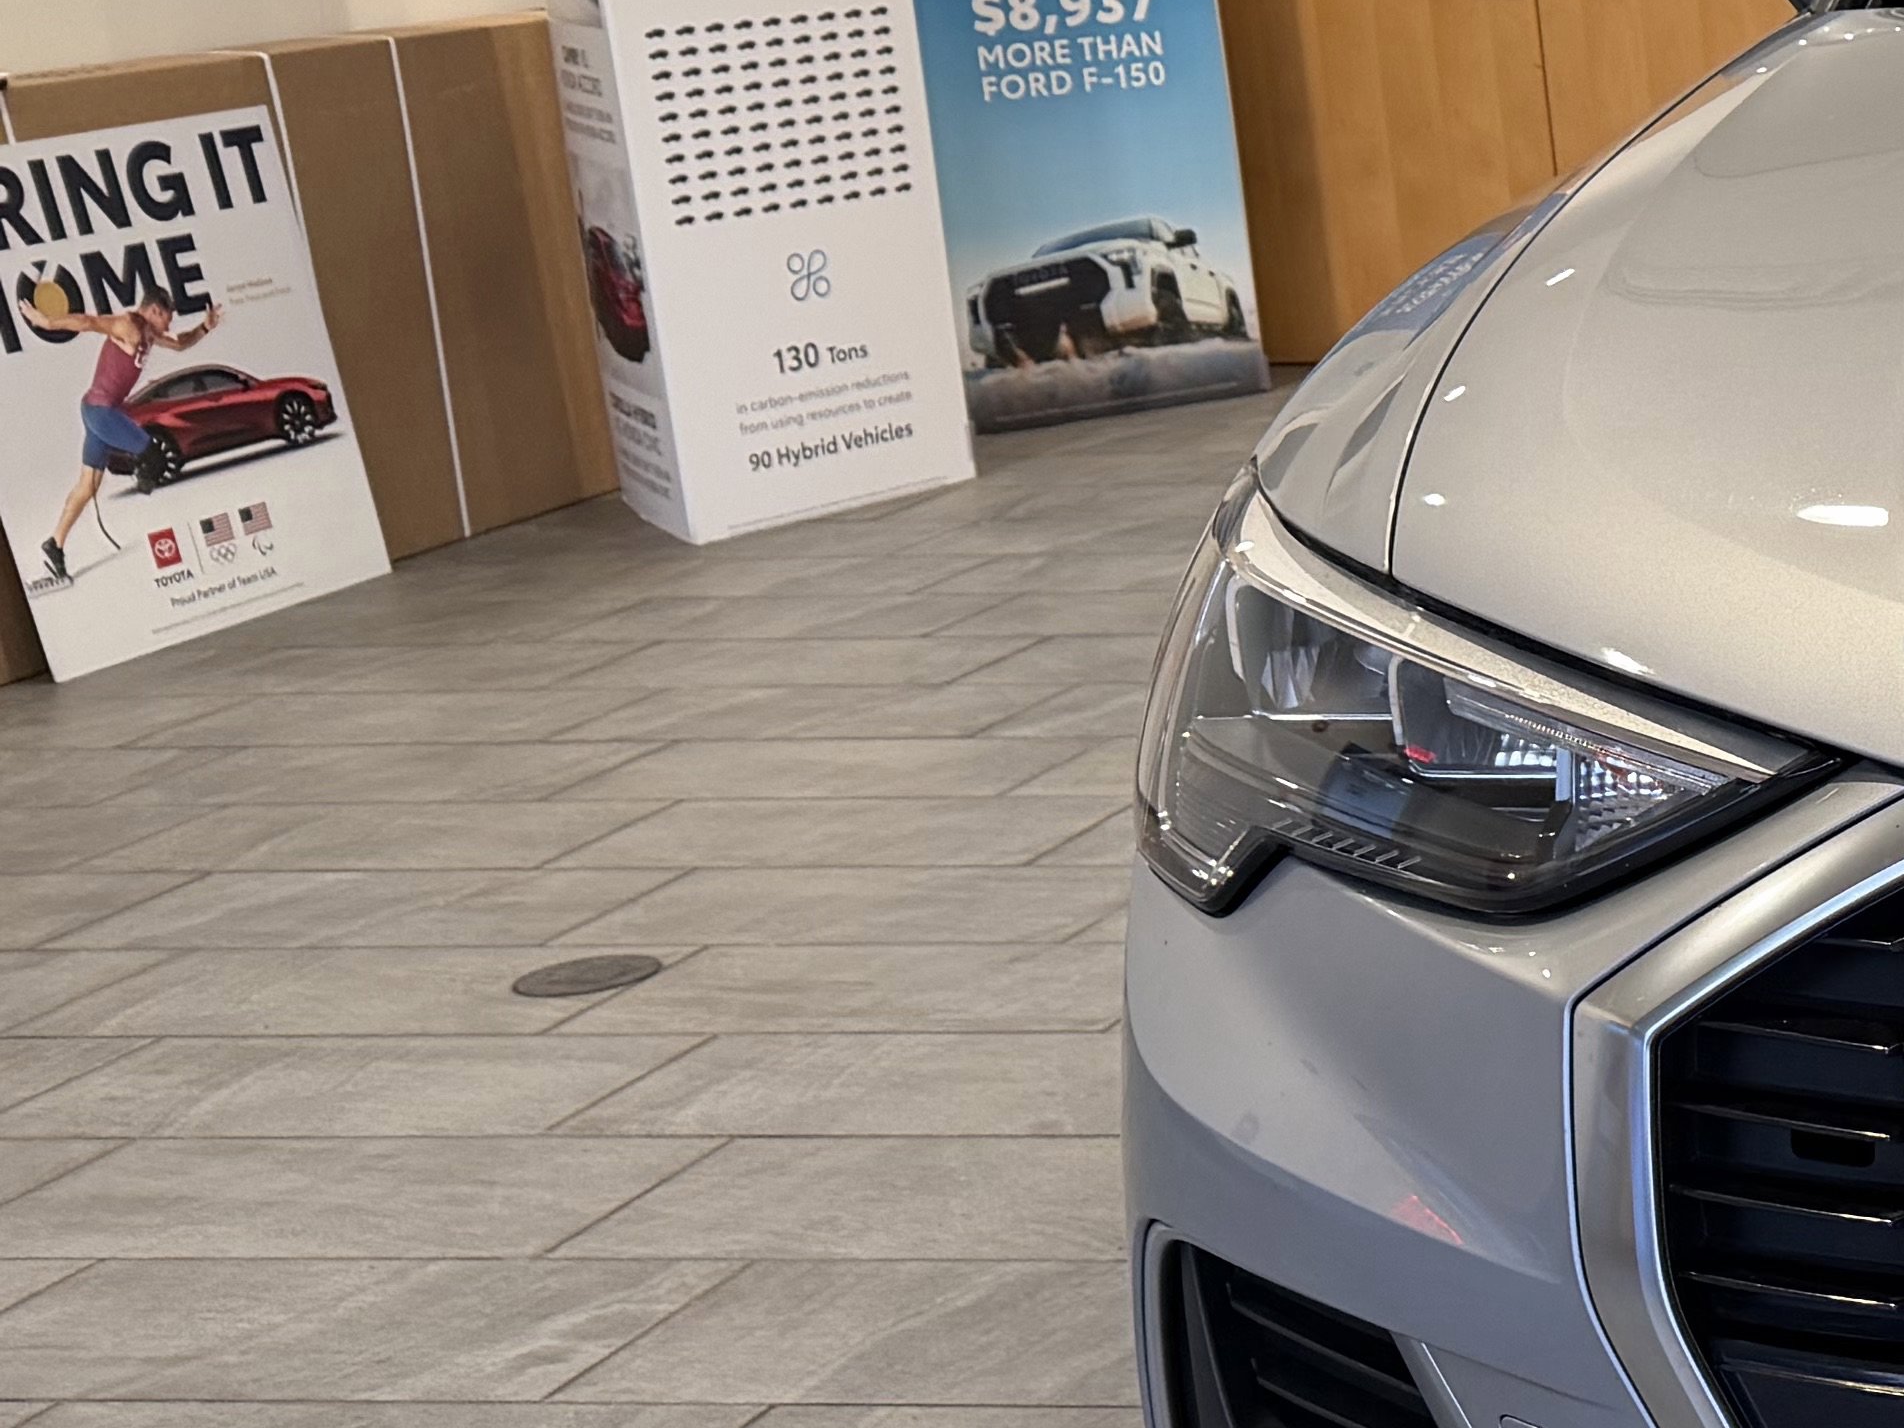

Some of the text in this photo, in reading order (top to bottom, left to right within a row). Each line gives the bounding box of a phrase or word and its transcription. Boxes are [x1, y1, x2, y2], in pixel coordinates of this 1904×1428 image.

[976, 31, 1164, 71] MORE THAN
[981, 60, 1166, 103] FORD F-150
[198, 124, 267, 210] IT
[772, 341, 869, 375] 130 Tons
[736, 370, 911, 414] in carbon-emission reductions
[738, 390, 912, 436] from using resources to create
[748, 422, 914, 472] 90 Hybrid Vehicles
[154, 569, 194, 589] TOYOTA
